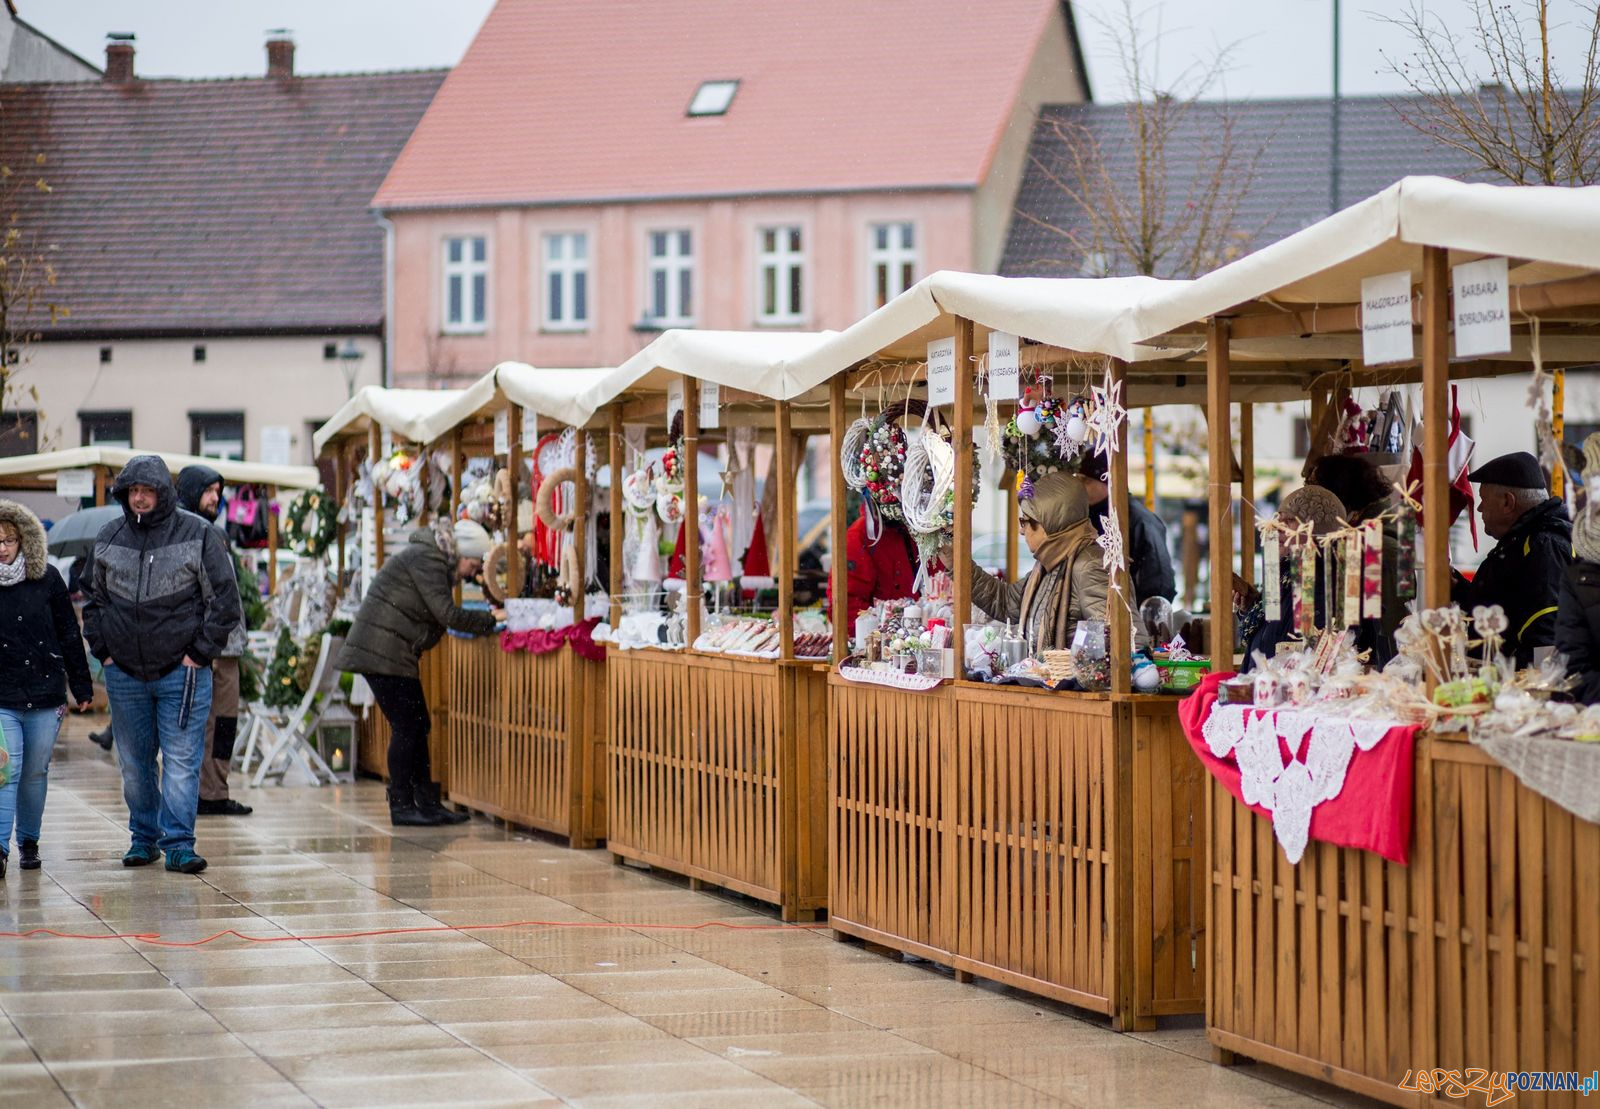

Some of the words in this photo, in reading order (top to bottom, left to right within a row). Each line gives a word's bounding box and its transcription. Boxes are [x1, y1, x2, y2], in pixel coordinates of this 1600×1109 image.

[1461, 281, 1499, 298] BARBARA
[1366, 293, 1409, 311] MAŁGORZATA
[1459, 308, 1504, 327] BOBROWSKA
